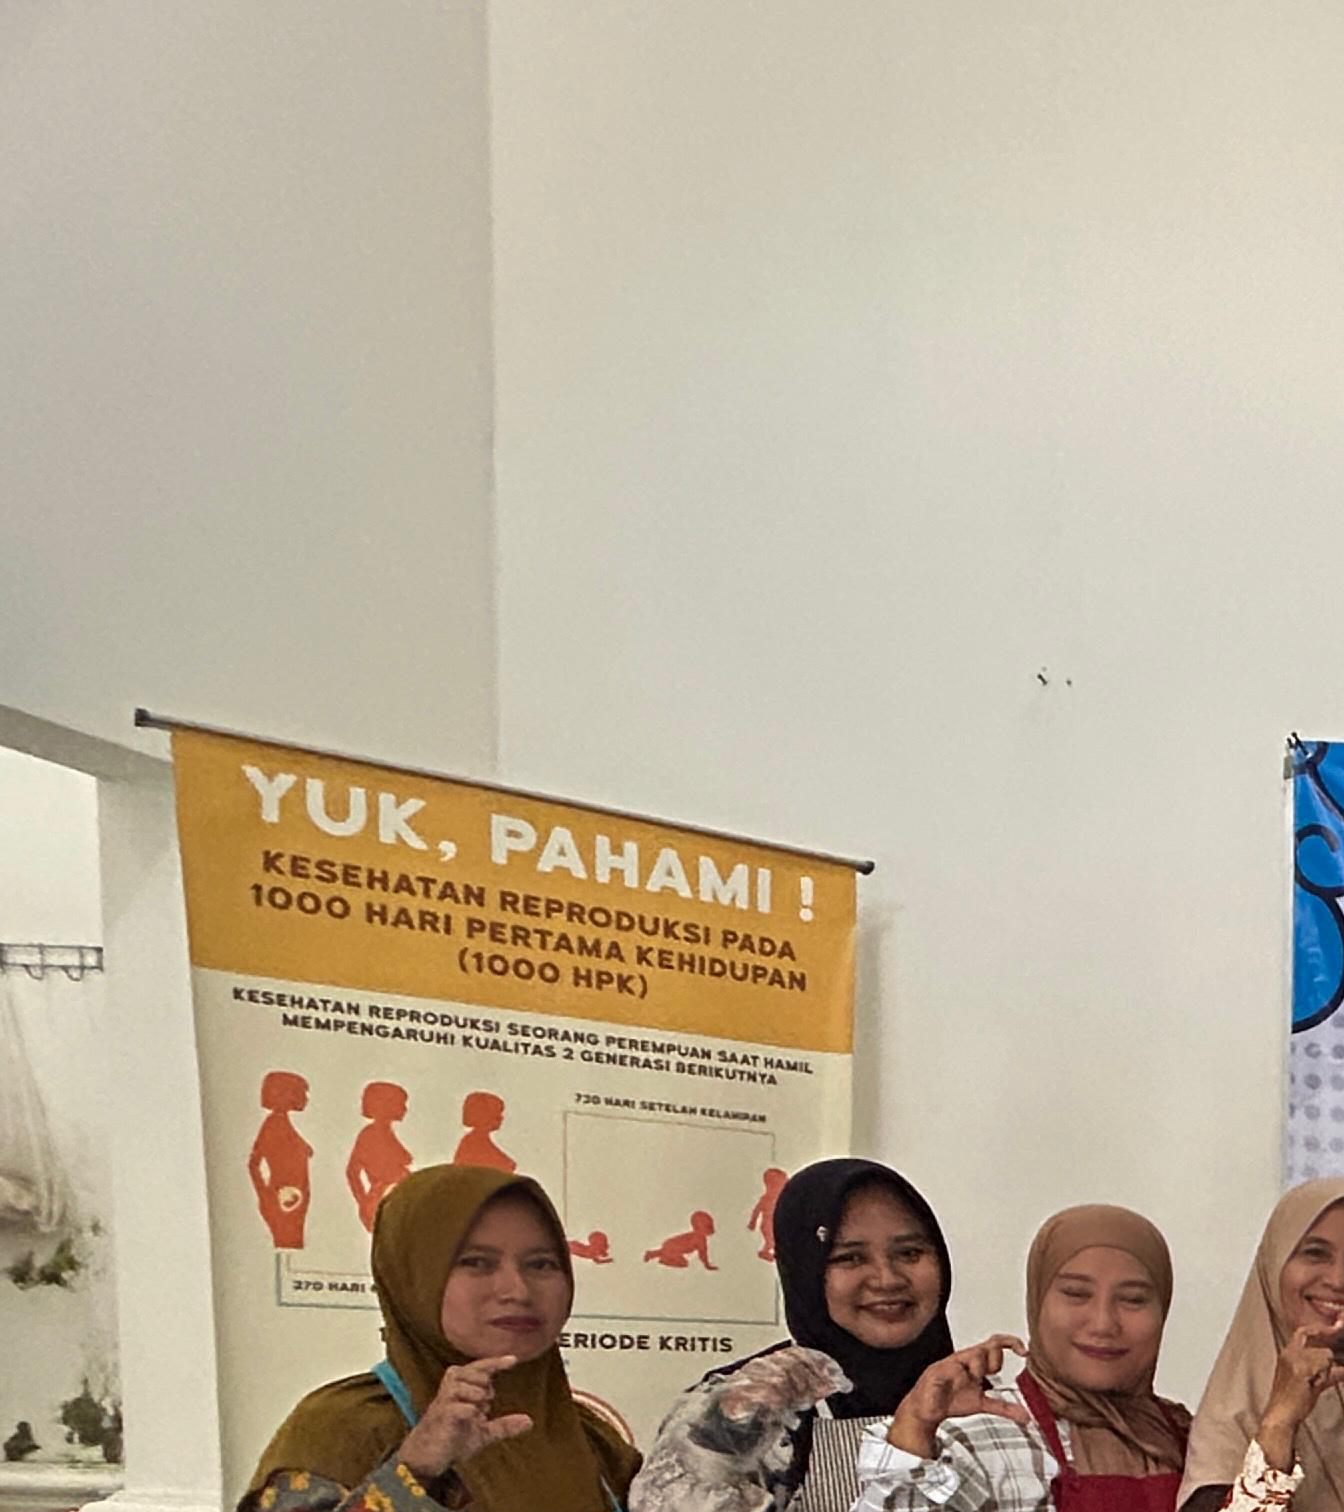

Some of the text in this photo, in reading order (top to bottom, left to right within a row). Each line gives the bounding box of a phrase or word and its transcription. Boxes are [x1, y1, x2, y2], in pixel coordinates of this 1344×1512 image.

[241, 764, 814, 921] YUK, PAHAMI !
[250, 882, 808, 992] 1000 HARI PERTAMA KEHIDUPAN
[262, 850, 797, 962] KESEHATAN REPRODUKSI PADA
[457, 946, 648, 999] (1000 HPK)
[232, 986, 814, 1075] KESEHATAN REPRODUKSI SEORANG PEREMPUAN SAAT HAMIL
[281, 1012, 778, 1086] MEMPENGARUHI KUALITAS 2 GENERASI BERIKUTNYA
[603, 1096, 636, 1109] HARI
[639, 1100, 698, 1116] SETELAH
[293, 1280, 324, 1292] 270
[328, 1281, 366, 1293] HARI
[558, 1332, 734, 1353] ERIODE KRITIS
